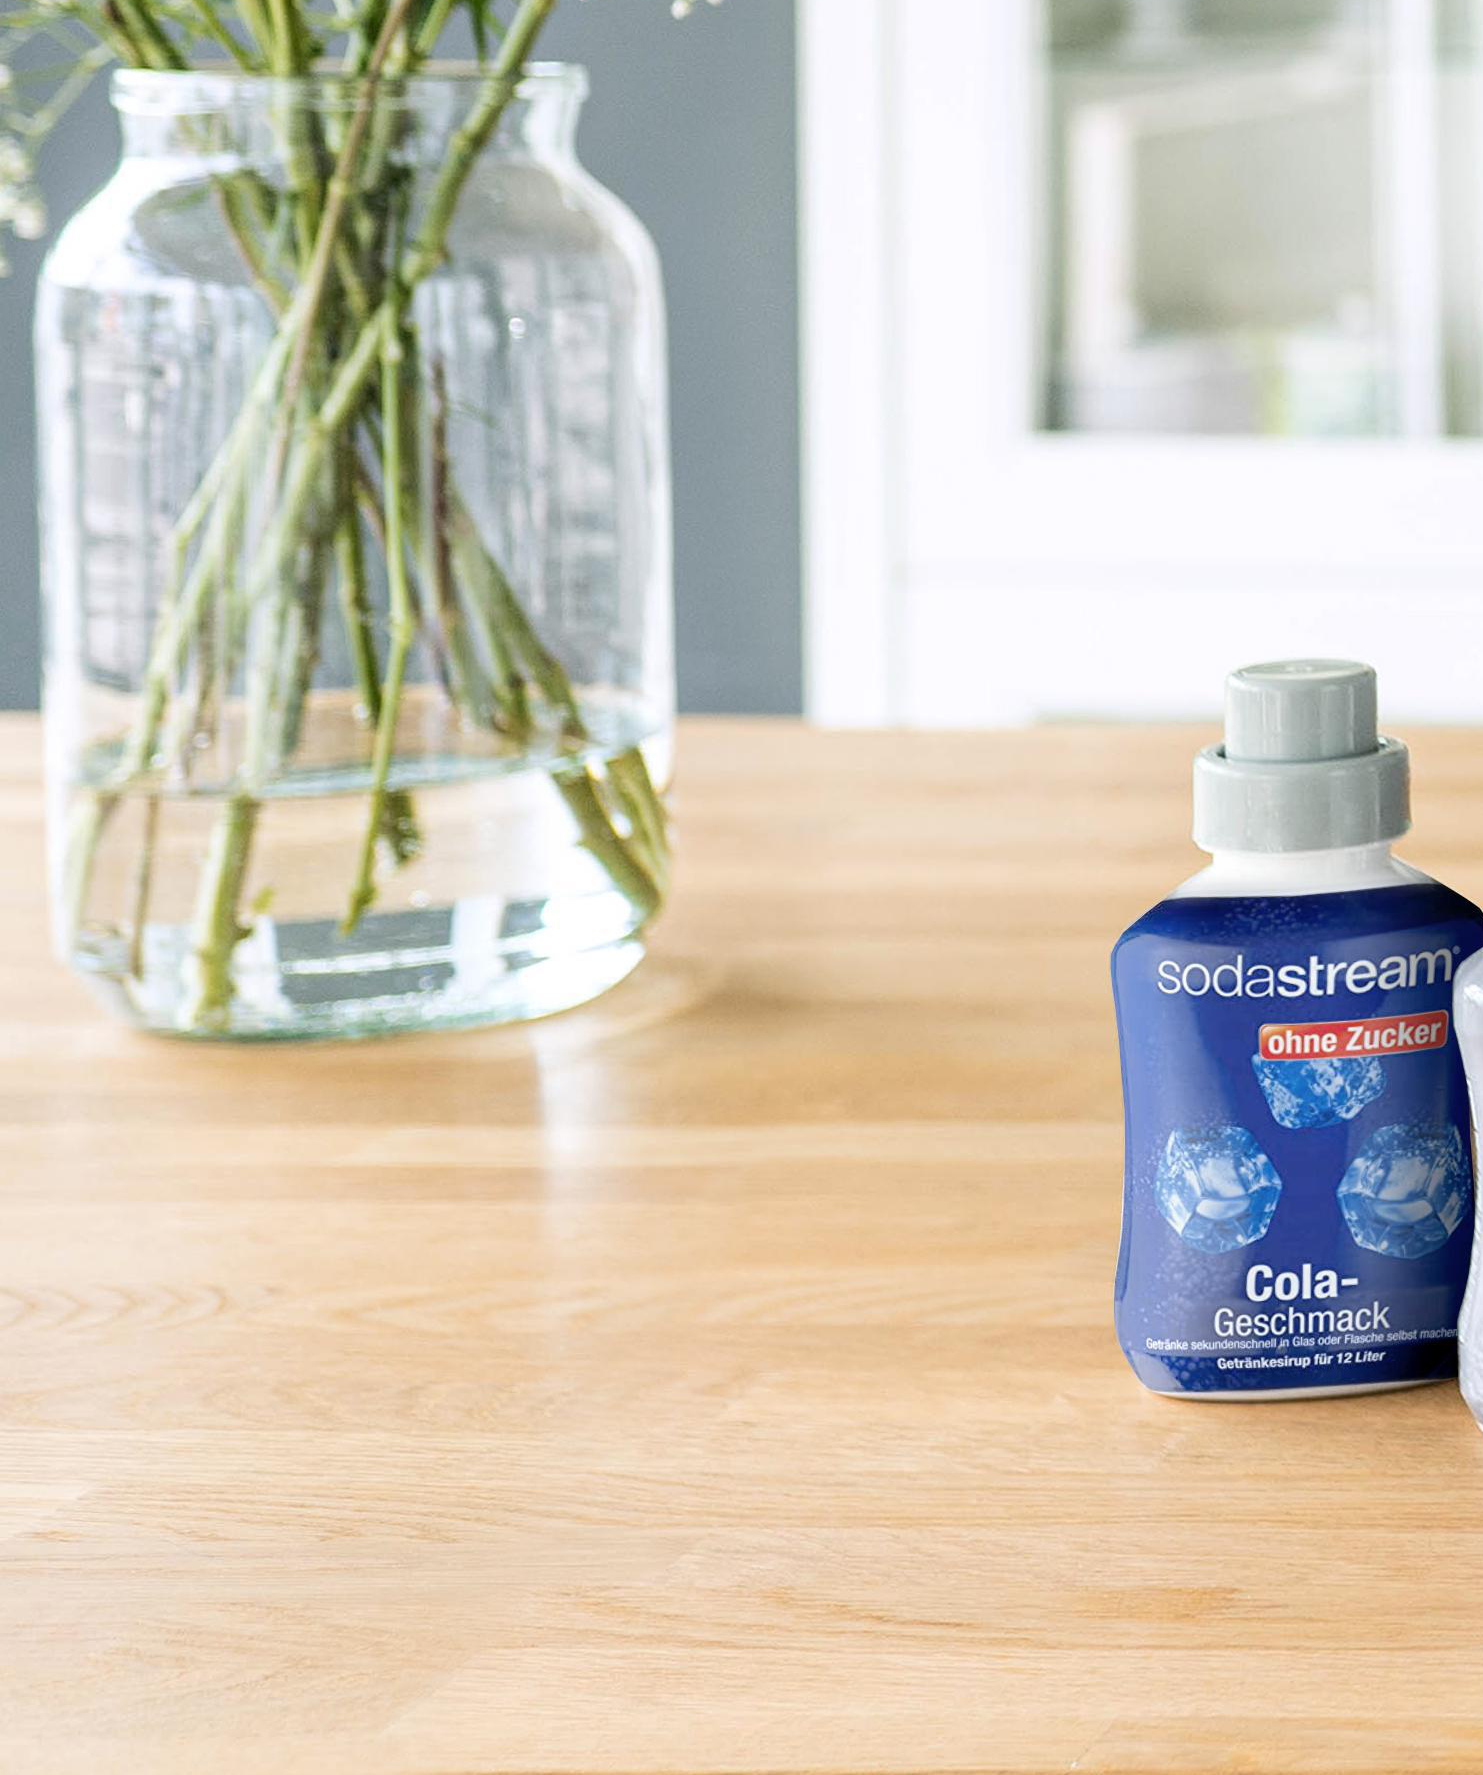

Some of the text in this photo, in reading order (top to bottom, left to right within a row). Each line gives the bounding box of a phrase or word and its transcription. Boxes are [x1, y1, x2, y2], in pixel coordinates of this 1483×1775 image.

[1267, 1021, 1442, 1055] ohne Zucker
[1245, 1263, 1359, 1303] Cola-
[1213, 1300, 1391, 1338] Geschmack
[1145, 1337, 1189, 1351] Getränke
[1190, 1337, 1277, 1351] sekundenschnell
[1280, 1337, 1290, 1348] in
[1292, 1335, 1315, 1347] Glas
[1318, 1334, 1341, 1346] oder
[1344, 1330, 1386, 1344] Flasche
[1387, 1328, 1417, 1342] selbst
[1216, 1350, 1386, 1369] Getränkesirup für 12 Liter
